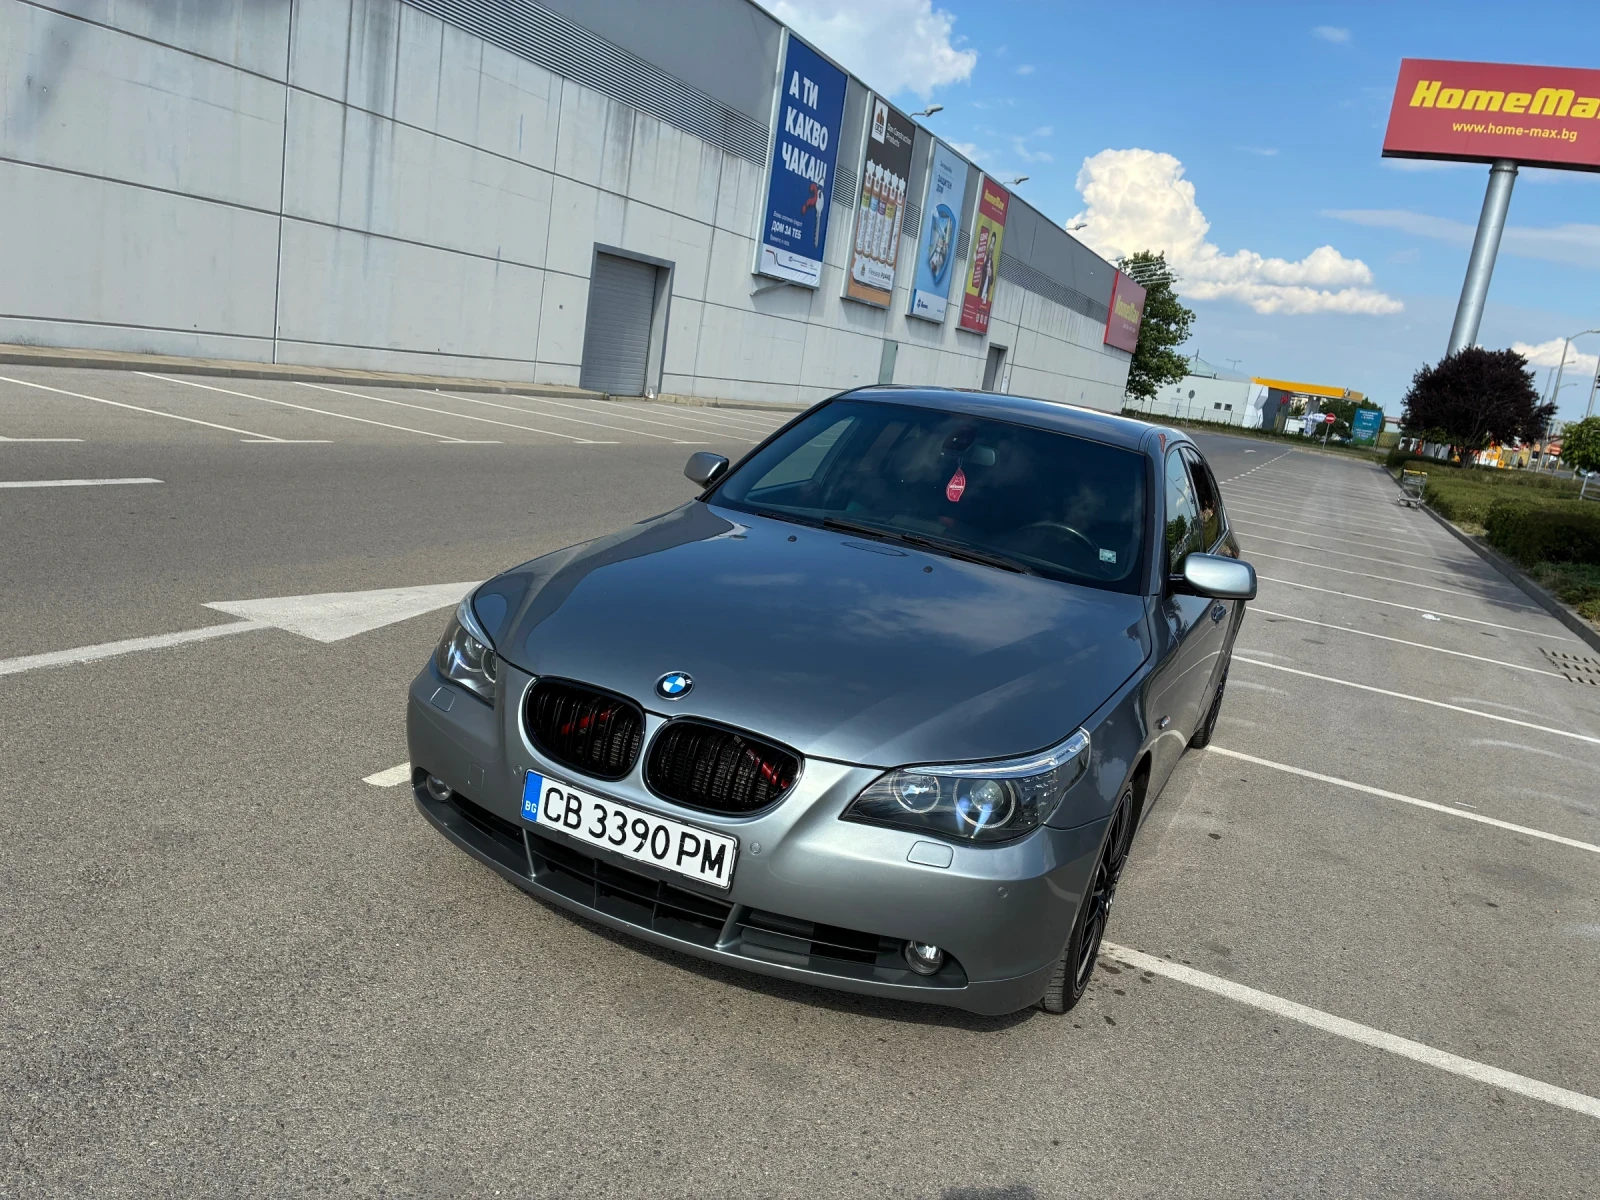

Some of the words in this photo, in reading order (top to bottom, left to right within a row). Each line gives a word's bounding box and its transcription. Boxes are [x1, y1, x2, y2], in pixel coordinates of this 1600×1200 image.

[789, 70, 799, 99] А
[803, 76, 819, 110] ТИ
[1409, 79, 1600, 119] HomeMa
[785, 105, 828, 151] КАКВО
[1452, 122, 1578, 142] www.home-max.bg
[782, 141, 828, 187] ЧАКАШ
[771, 220, 784, 233] ДОМ
[784, 225, 792, 237] ЗА
[792, 227, 802, 240] ТЕБ
[525, 800, 537, 813] BG
[543, 787, 582, 829] CB
[588, 804, 670, 861] 3390
[676, 831, 727, 879] PM
